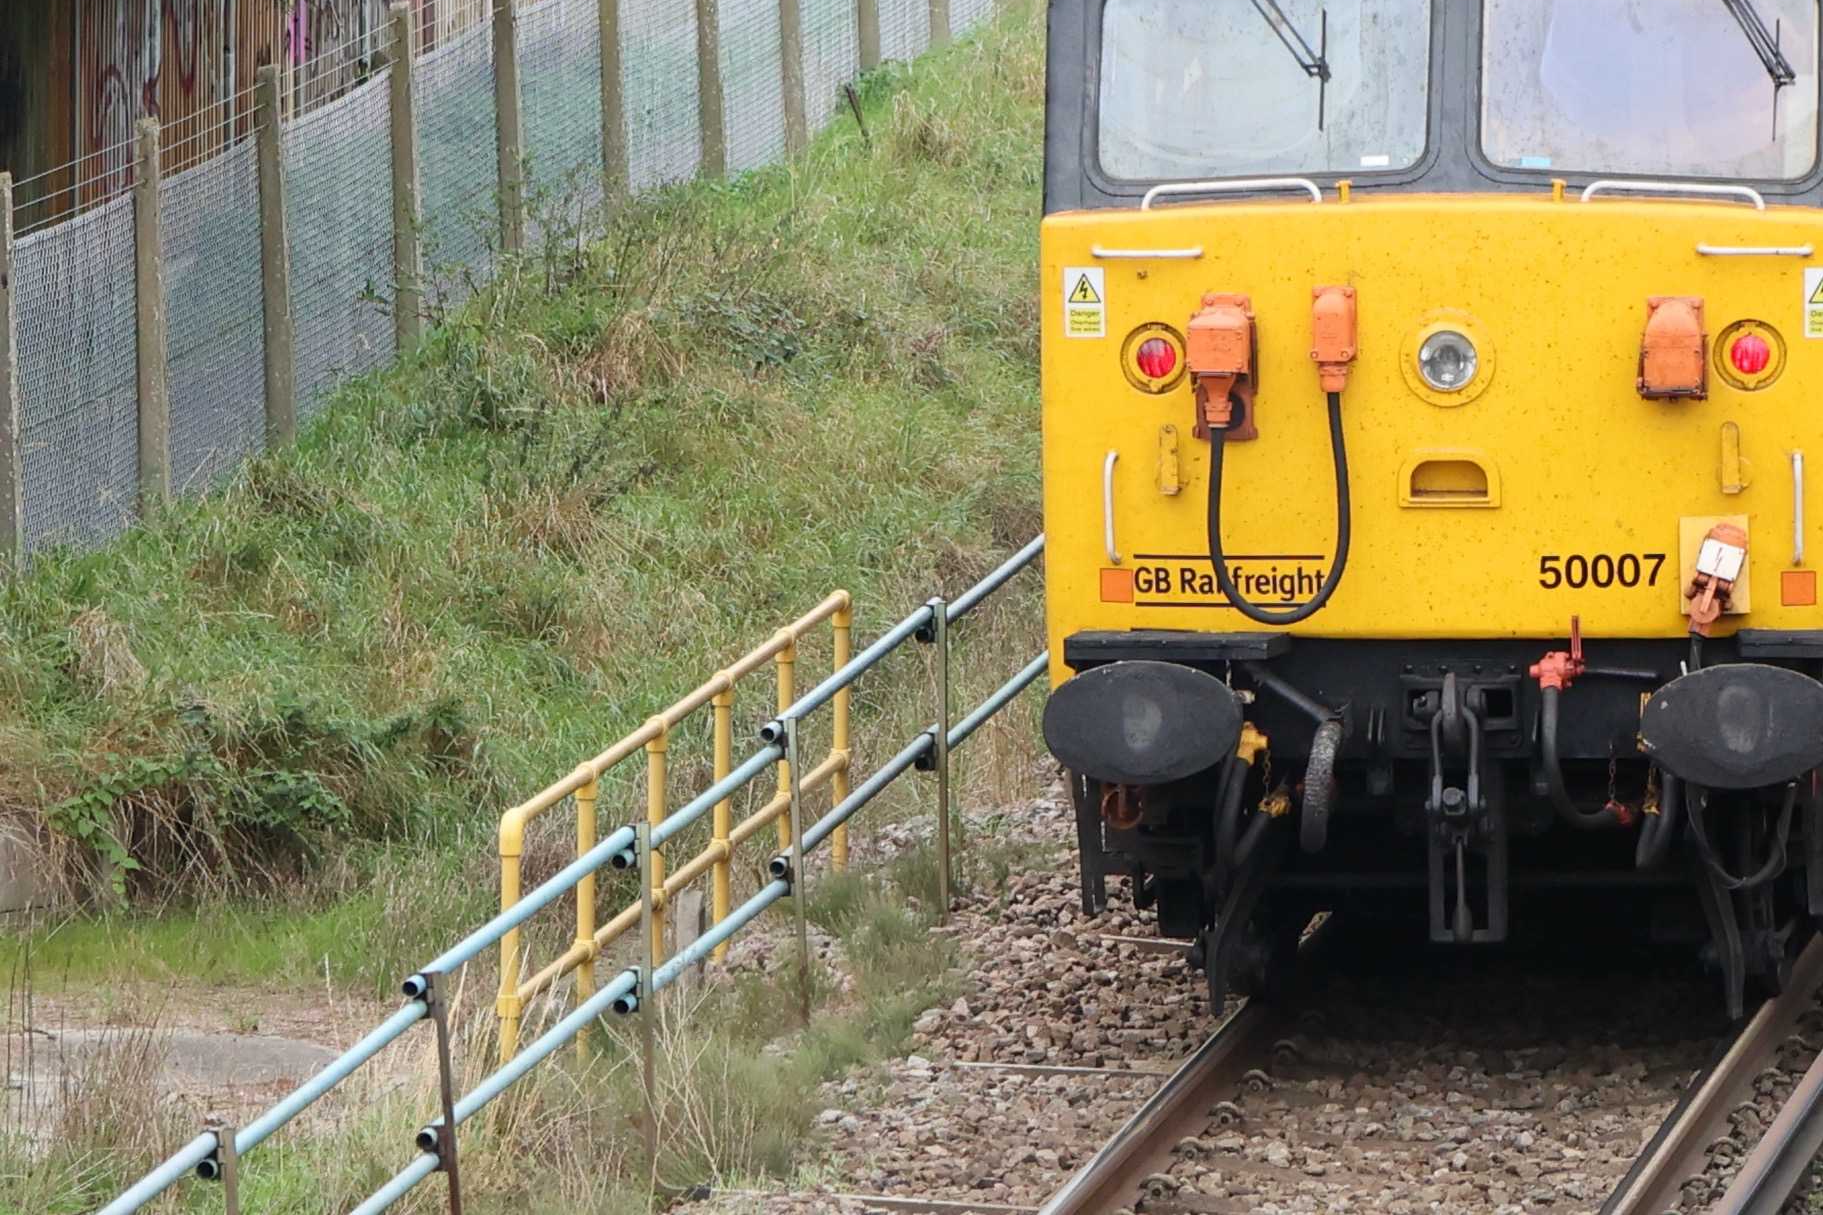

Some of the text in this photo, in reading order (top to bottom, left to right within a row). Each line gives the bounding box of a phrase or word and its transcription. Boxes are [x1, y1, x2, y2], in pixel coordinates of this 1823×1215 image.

[1134, 566, 1325, 602] GB Raifreight
[1539, 553, 1666, 589] 50007
